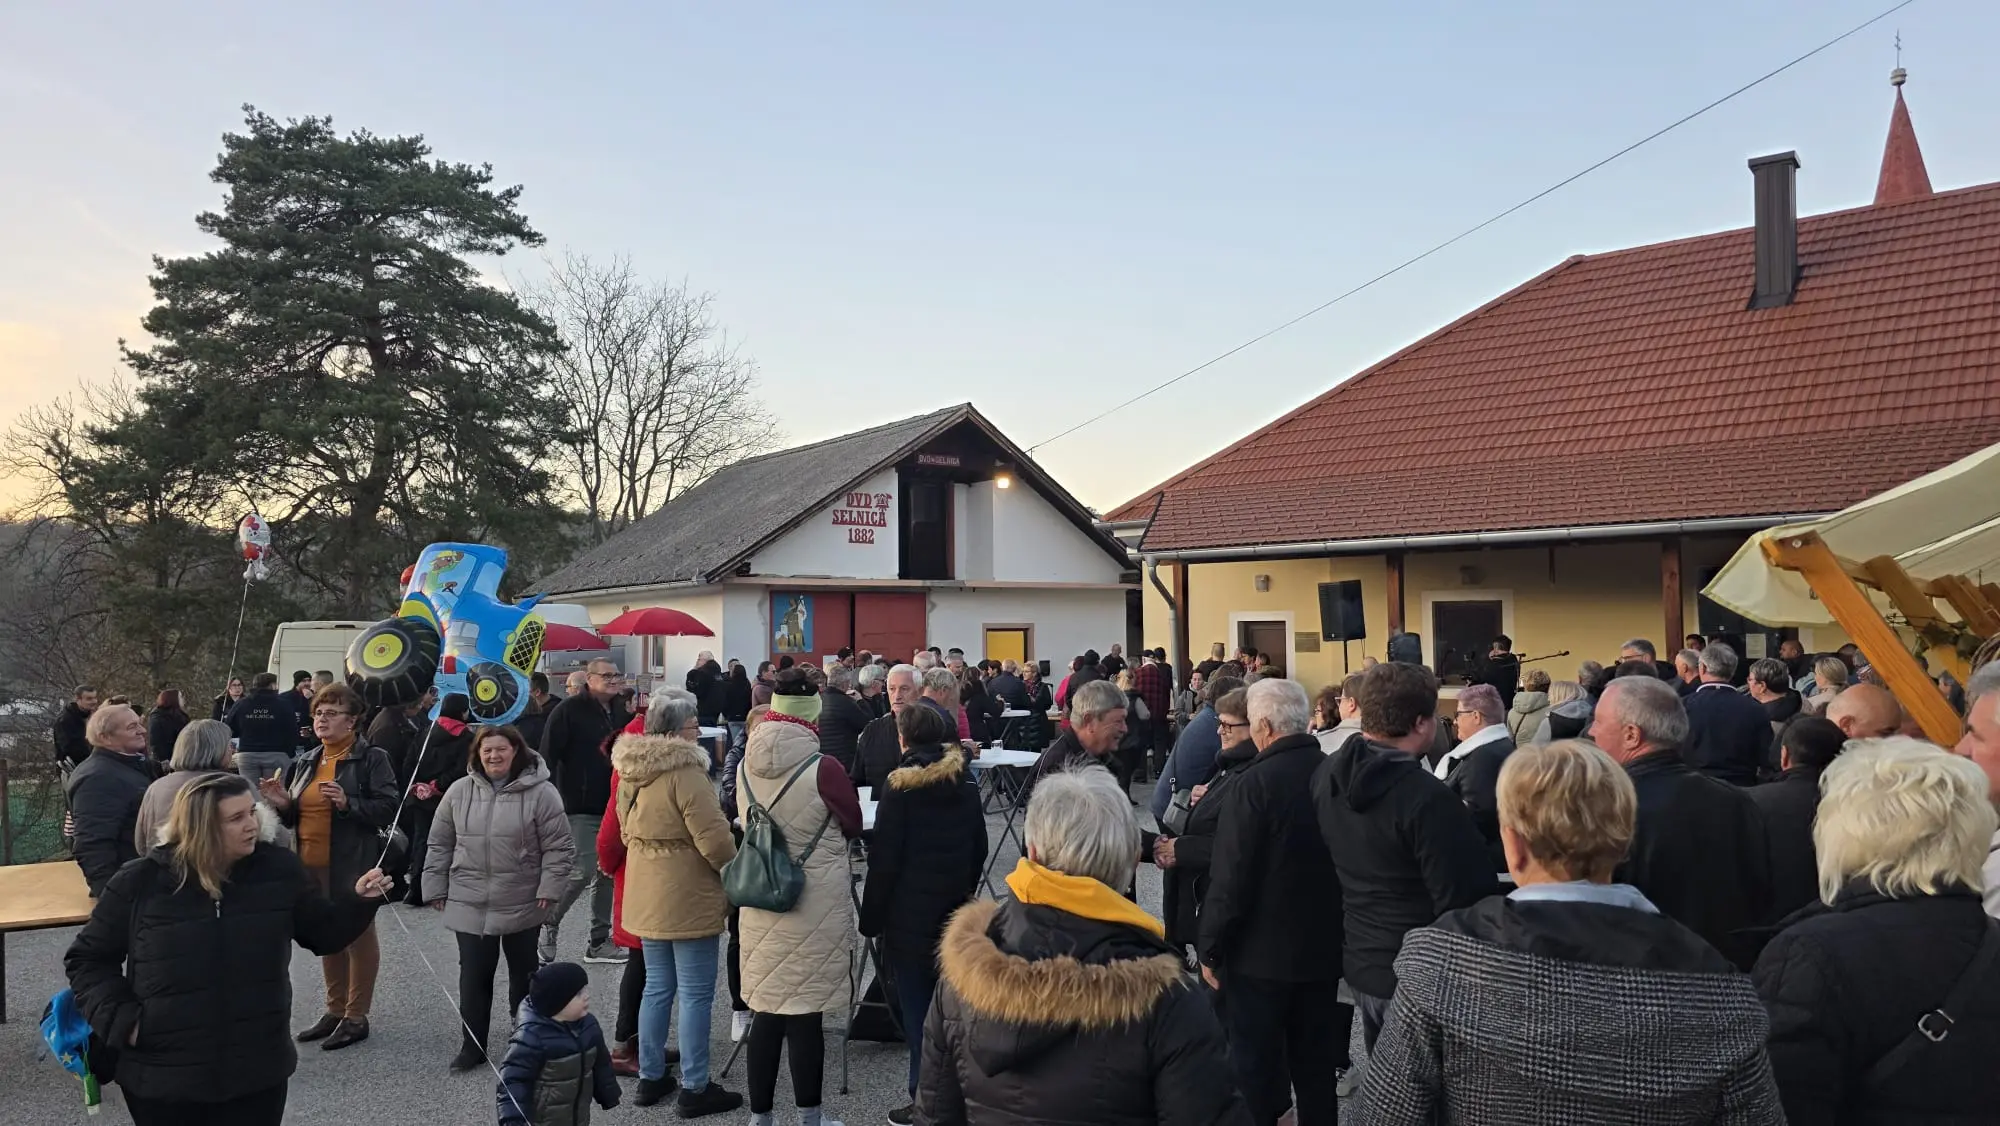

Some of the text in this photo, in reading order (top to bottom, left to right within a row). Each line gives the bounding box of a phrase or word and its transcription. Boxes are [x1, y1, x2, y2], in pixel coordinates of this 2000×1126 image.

[846, 492, 872, 508] DVD
[832, 509, 887, 527] SELNICA
[848, 528, 874, 544] 1882
